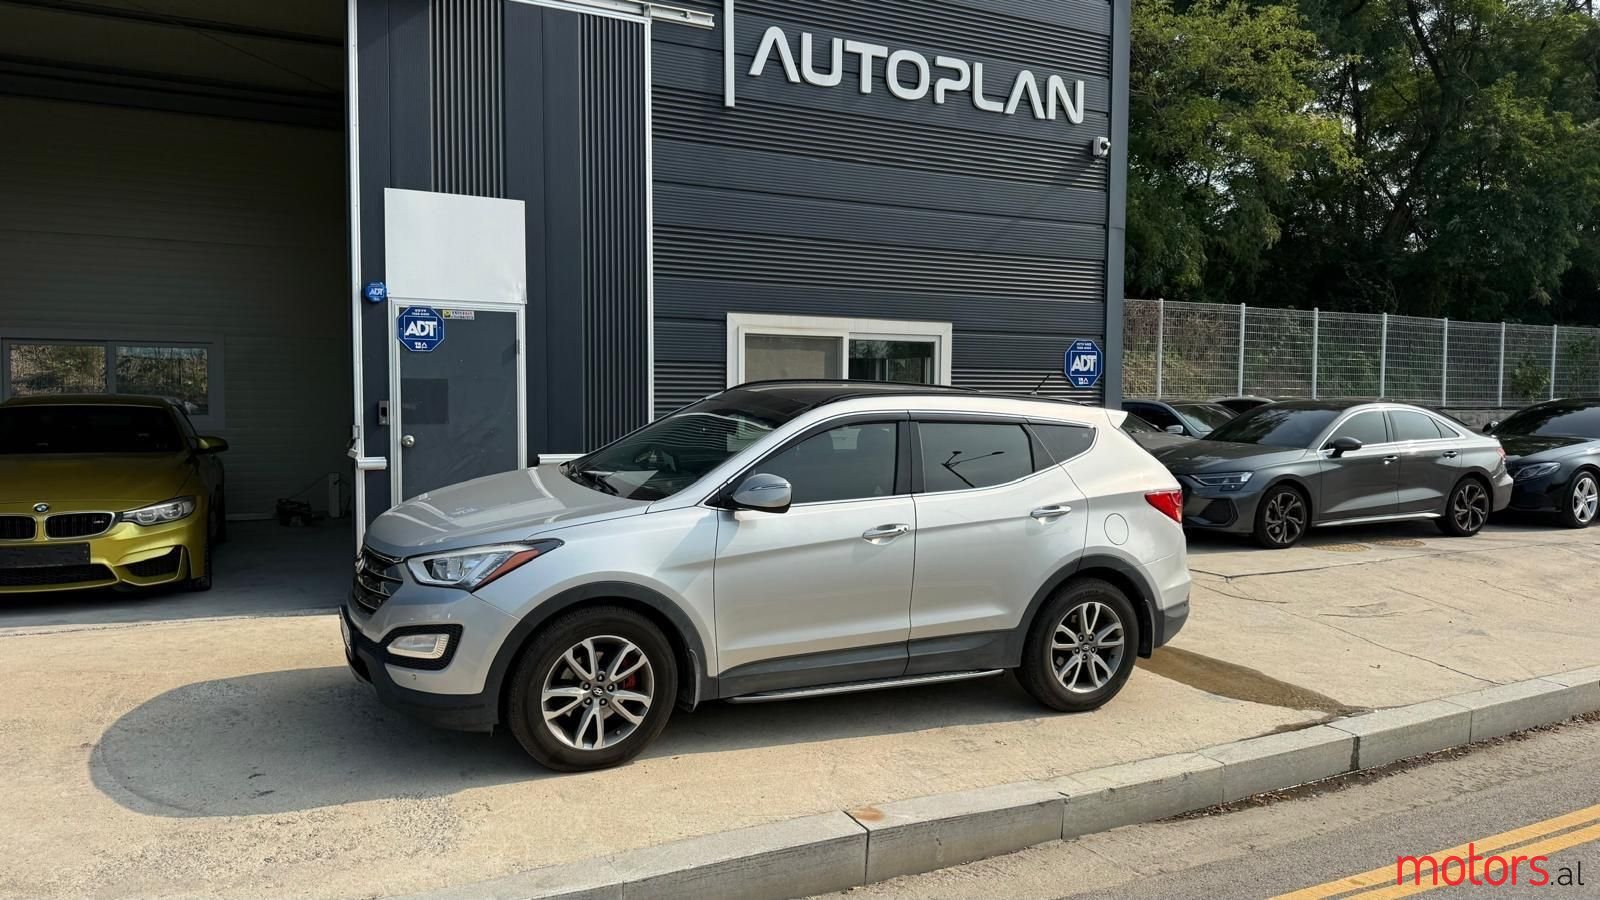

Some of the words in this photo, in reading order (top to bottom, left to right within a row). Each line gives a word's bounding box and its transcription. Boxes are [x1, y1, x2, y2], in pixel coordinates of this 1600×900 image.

[748, 25, 1085, 125] AUTOPLAN
[369, 287, 384, 296] ADT
[404, 320, 437, 337] ADT
[1070, 354, 1097, 372] ADT
